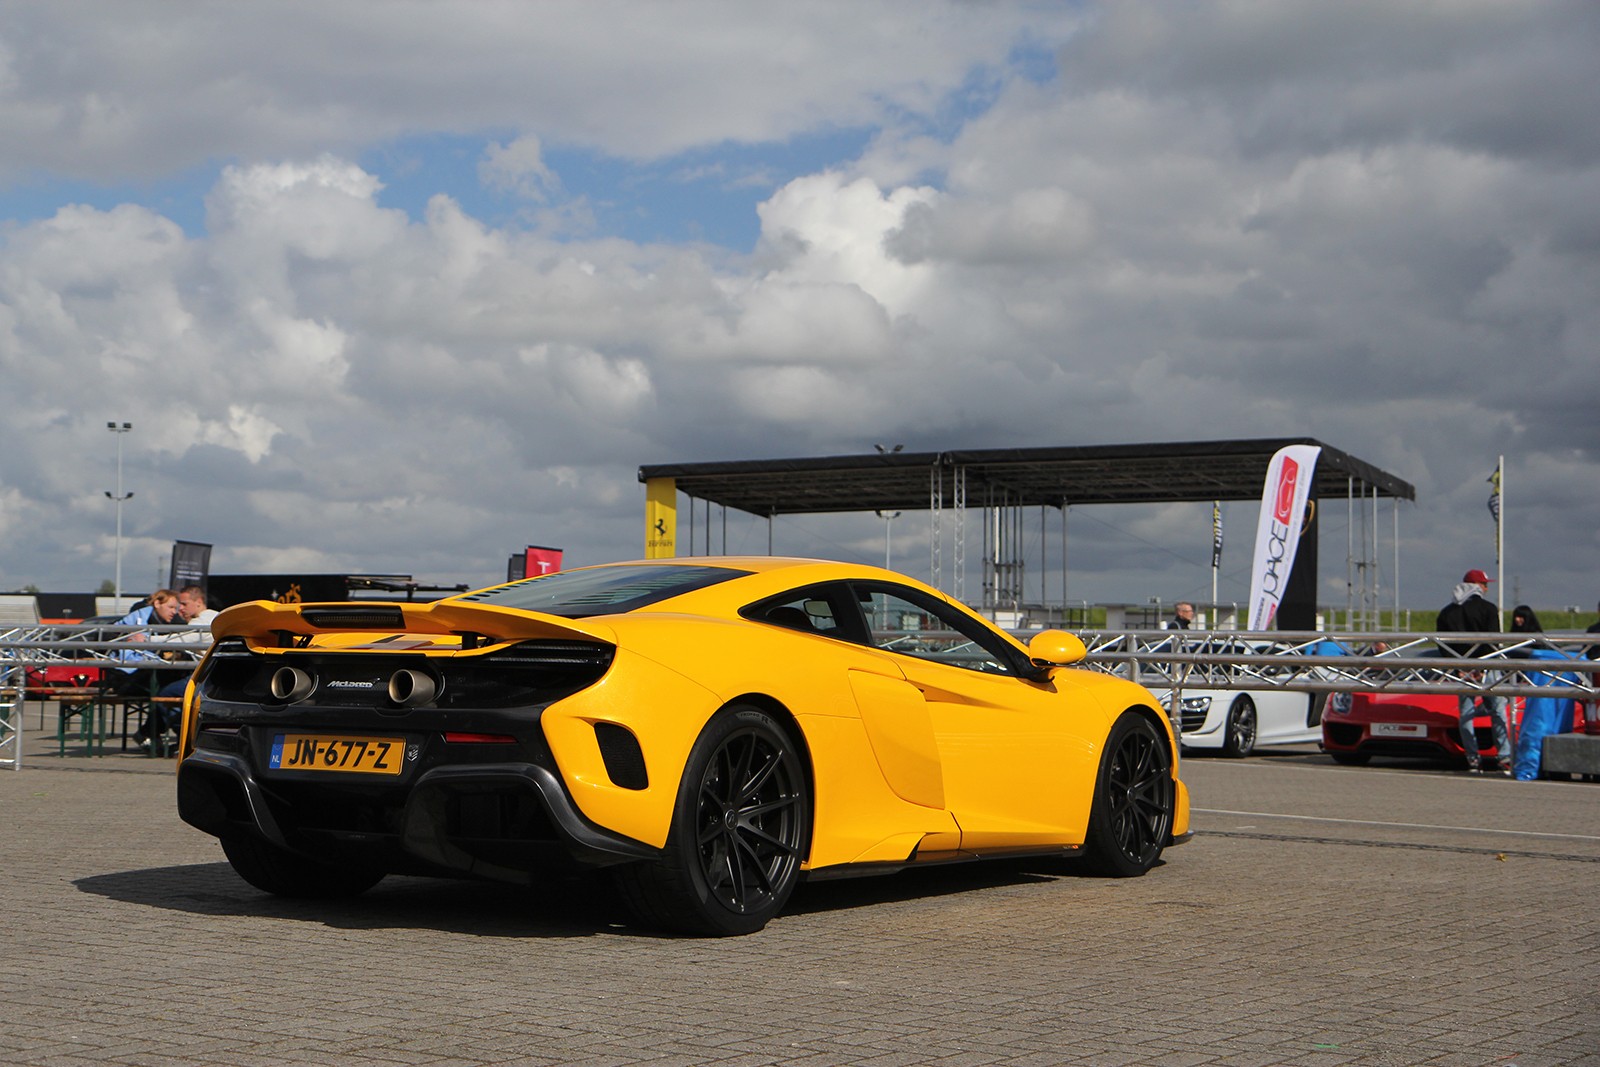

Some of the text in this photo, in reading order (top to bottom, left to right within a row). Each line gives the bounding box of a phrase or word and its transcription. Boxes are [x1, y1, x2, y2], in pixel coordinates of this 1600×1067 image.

[1263, 520, 1288, 600] PACE
[271, 755, 280, 763] NL
[288, 739, 391, 769] JN-677-Z
